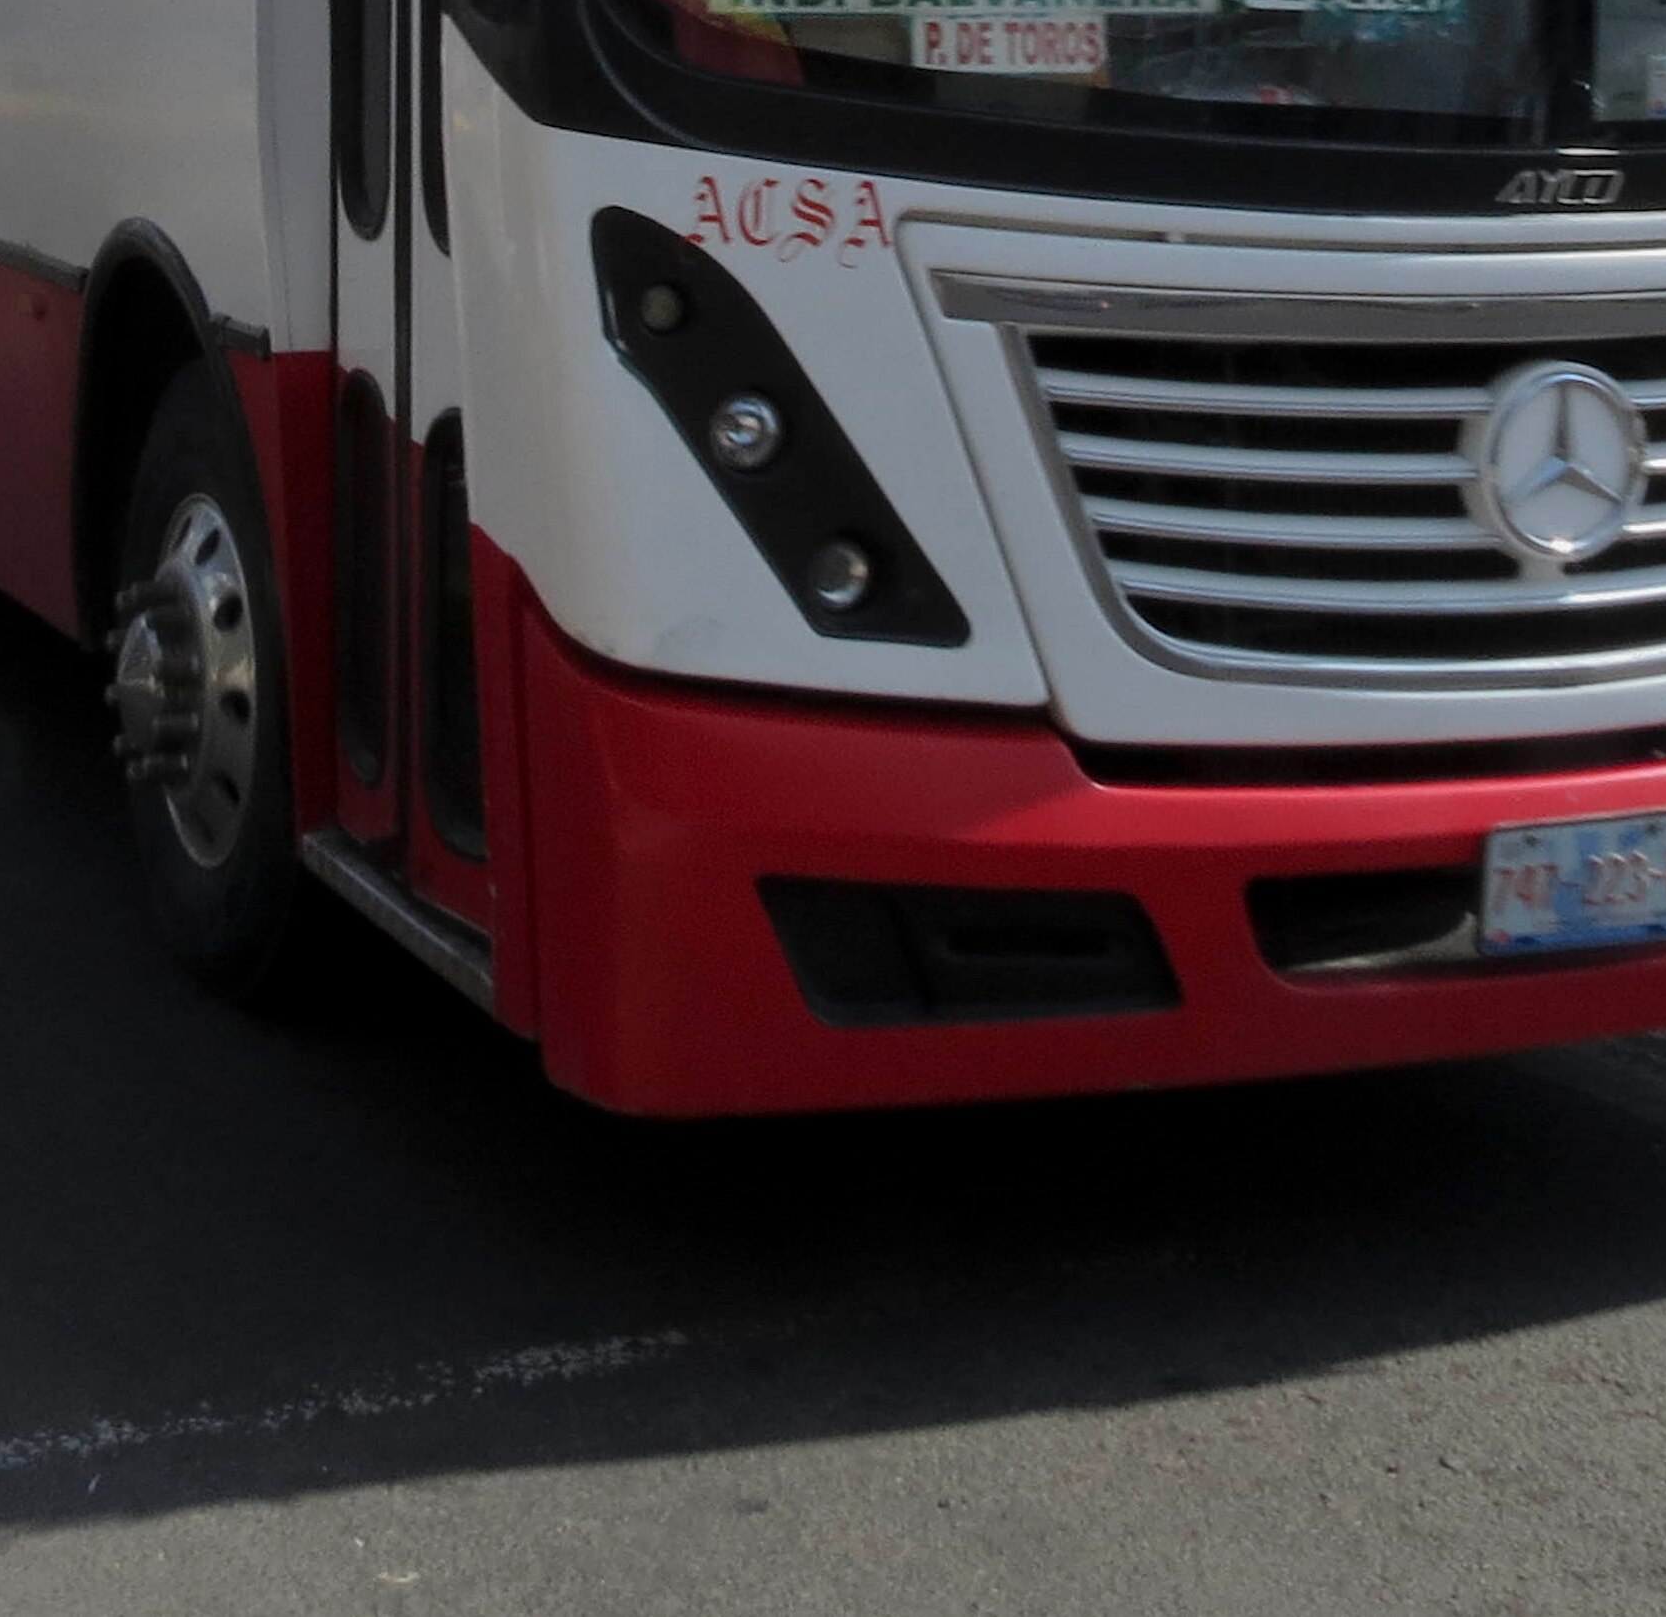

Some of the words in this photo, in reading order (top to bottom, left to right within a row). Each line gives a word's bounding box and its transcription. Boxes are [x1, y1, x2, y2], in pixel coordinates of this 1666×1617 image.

[954, 20, 996, 66] DE
[1002, 20, 1103, 67] TOROS
[683, 176, 893, 262] ACSA
